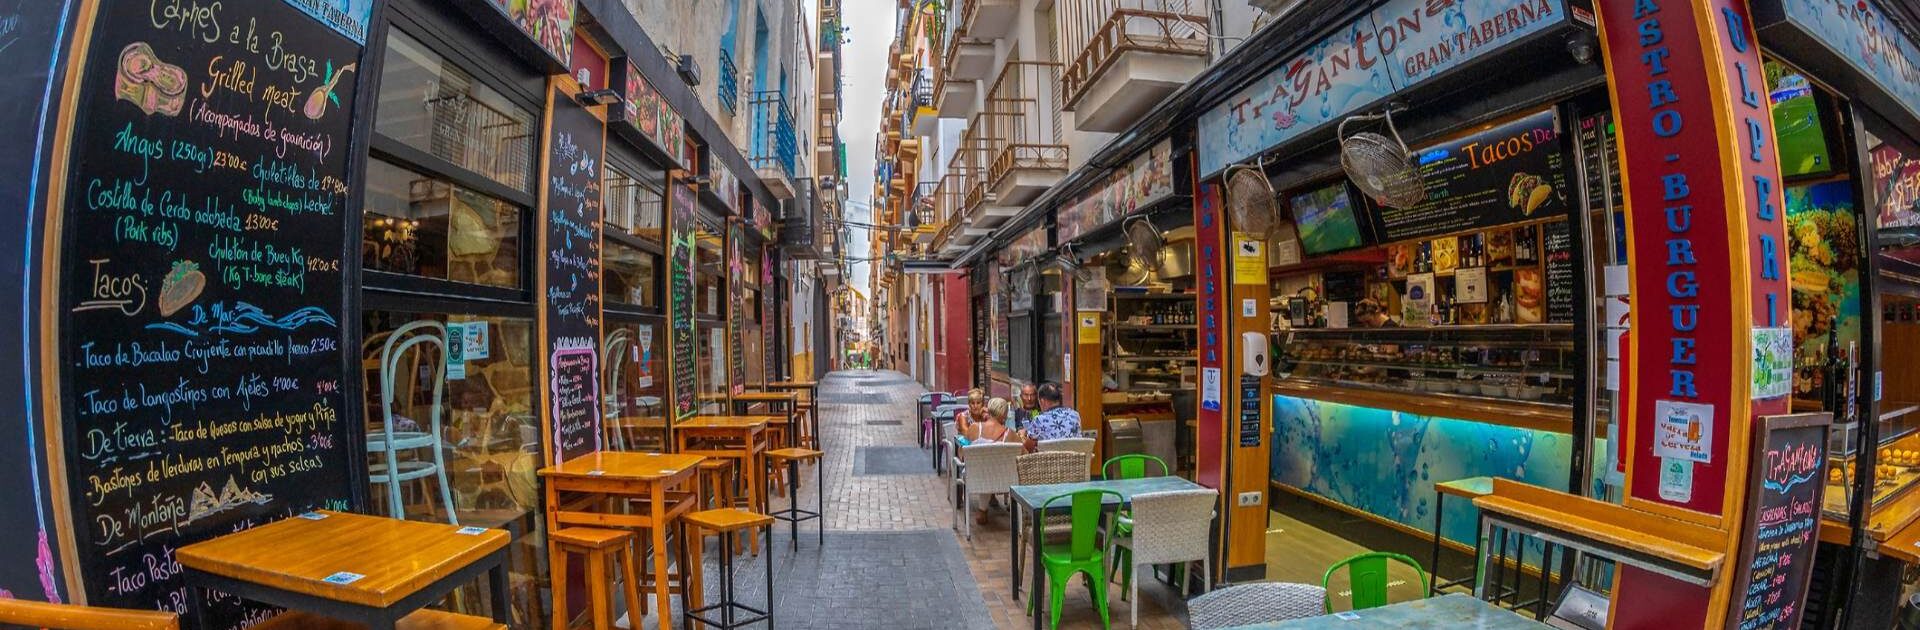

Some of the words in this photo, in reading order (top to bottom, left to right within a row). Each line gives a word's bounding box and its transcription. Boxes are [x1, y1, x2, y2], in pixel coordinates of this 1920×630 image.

[322, 2, 365, 38] TABERNA
[1405, 39, 1452, 77] GRAN
[1454, 0, 1553, 54] TABERNA
[151, 0, 222, 42] Carnes
[230, 25, 239, 43] a
[246, 17, 259, 53] la
[266, 31, 318, 83] Brasa
[202, 56, 256, 102] Grilled
[263, 84, 302, 124] meat
[264, 124, 277, 142] de
[1462, 132, 1533, 169] Tacos
[114, 122, 164, 186] Angus
[308, 166, 320, 190] de
[88, 178, 137, 210] Costilla
[142, 190, 154, 216] de
[161, 191, 191, 222] Cerdo
[115, 215, 148, 247] (Pork
[152, 222, 179, 250] ribs)
[251, 242, 263, 263] de
[265, 244, 291, 270] Buey
[188, 306, 208, 325] De
[115, 339, 130, 365] de
[132, 344, 180, 367] Bacalao
[184, 338, 231, 374] Crujiente
[121, 387, 138, 410] de
[212, 384, 231, 399] con
[236, 372, 269, 411] Ajetes
[82, 429, 112, 460] De
[196, 420, 208, 438] de
[239, 420, 253, 434] con
[254, 414, 275, 429] salsa
[275, 413, 284, 427] de
[308, 412, 315, 430] y
[147, 465, 159, 482] de
[163, 457, 203, 481] Verduras
[207, 457, 220, 468] en
[262, 446, 270, 465] y
[270, 438, 304, 459] nachos
[251, 469, 269, 484] con
[270, 464, 286, 479] sus
[289, 456, 323, 470] salsas
[95, 514, 124, 545] De
[125, 493, 187, 545] Montaña
